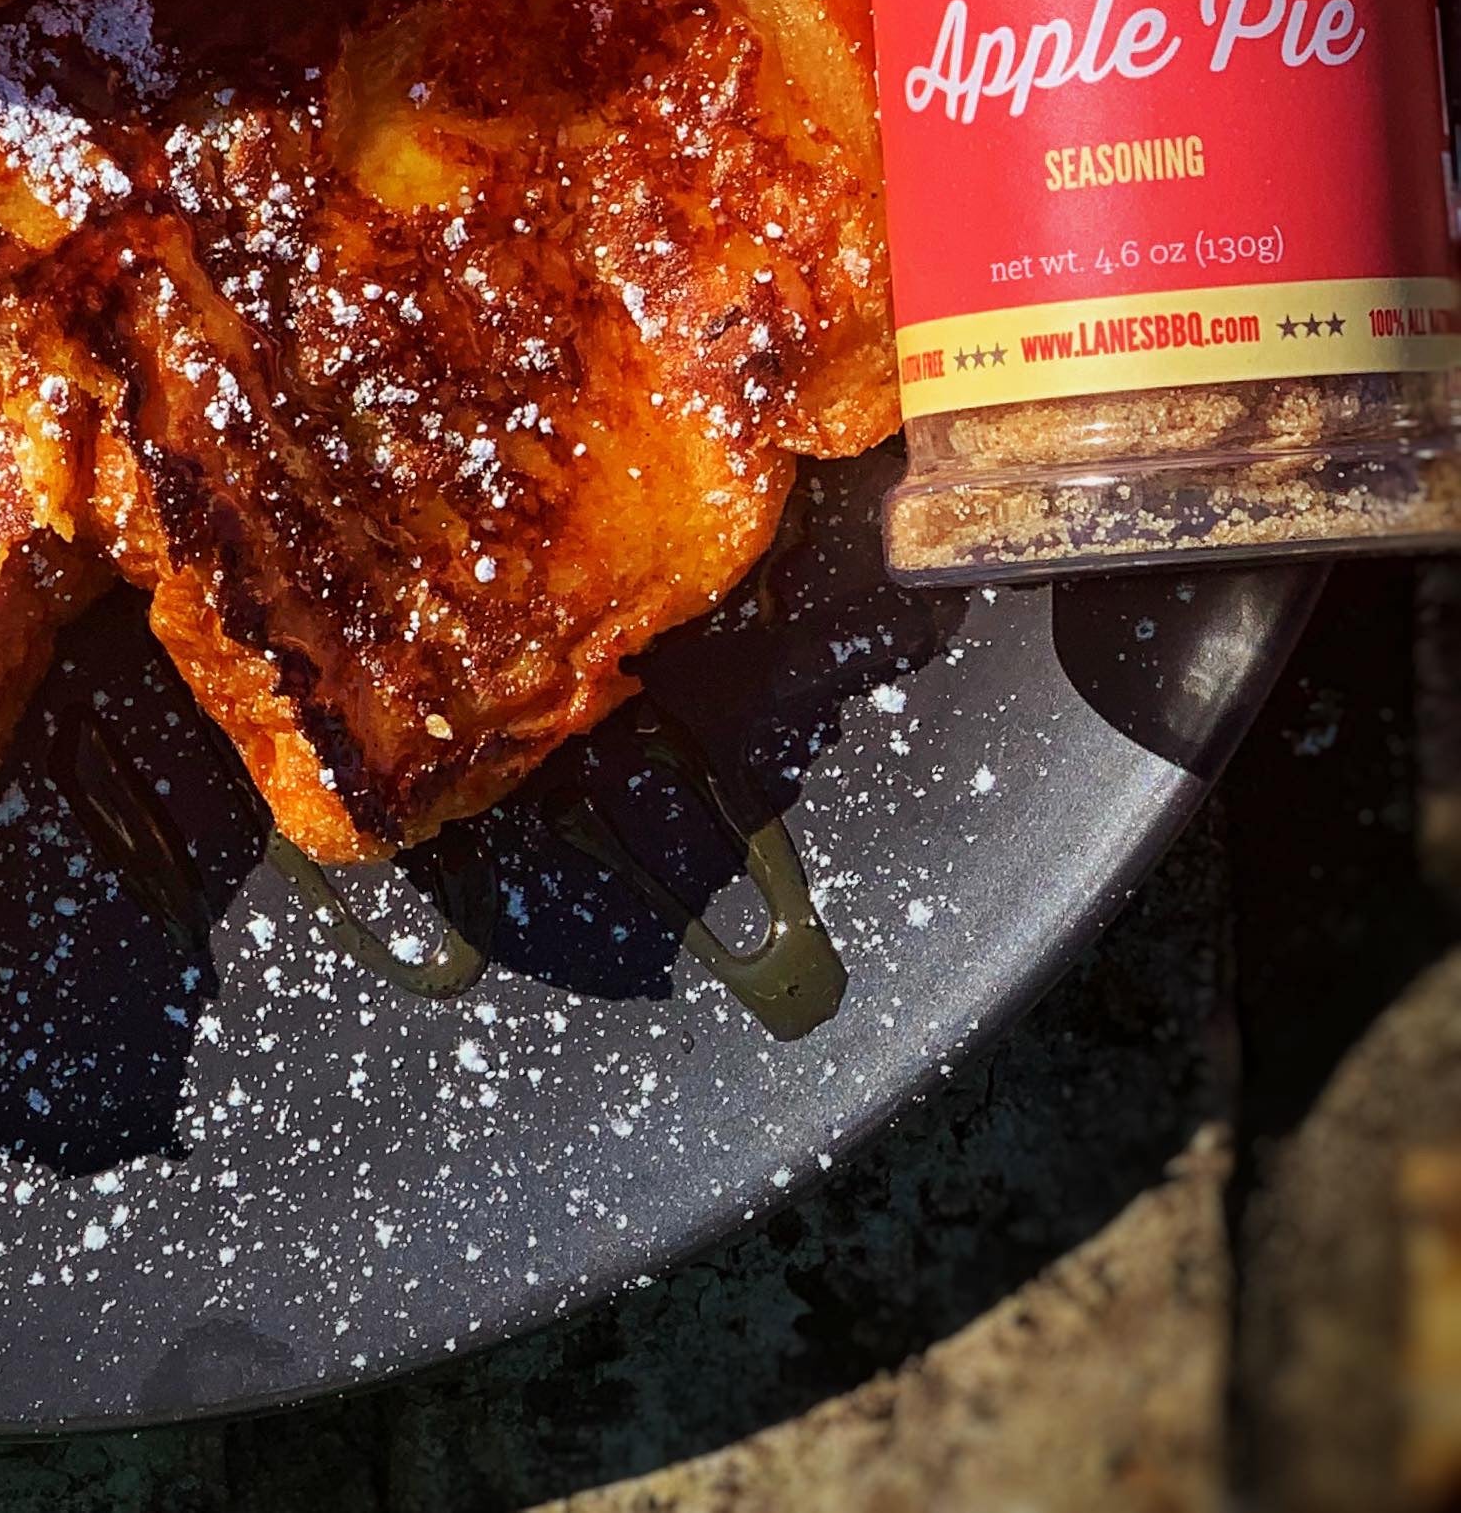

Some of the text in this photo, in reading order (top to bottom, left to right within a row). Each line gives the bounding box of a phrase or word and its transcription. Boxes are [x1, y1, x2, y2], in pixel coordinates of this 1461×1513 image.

[1045, 135, 1205, 191] SEASONING
[990, 225, 1285, 283] net wt. 4.6 oz (130g)
[1020, 311, 1260, 364] www.LANESBBQ.com
[1368, 308, 1405, 338] 100%
